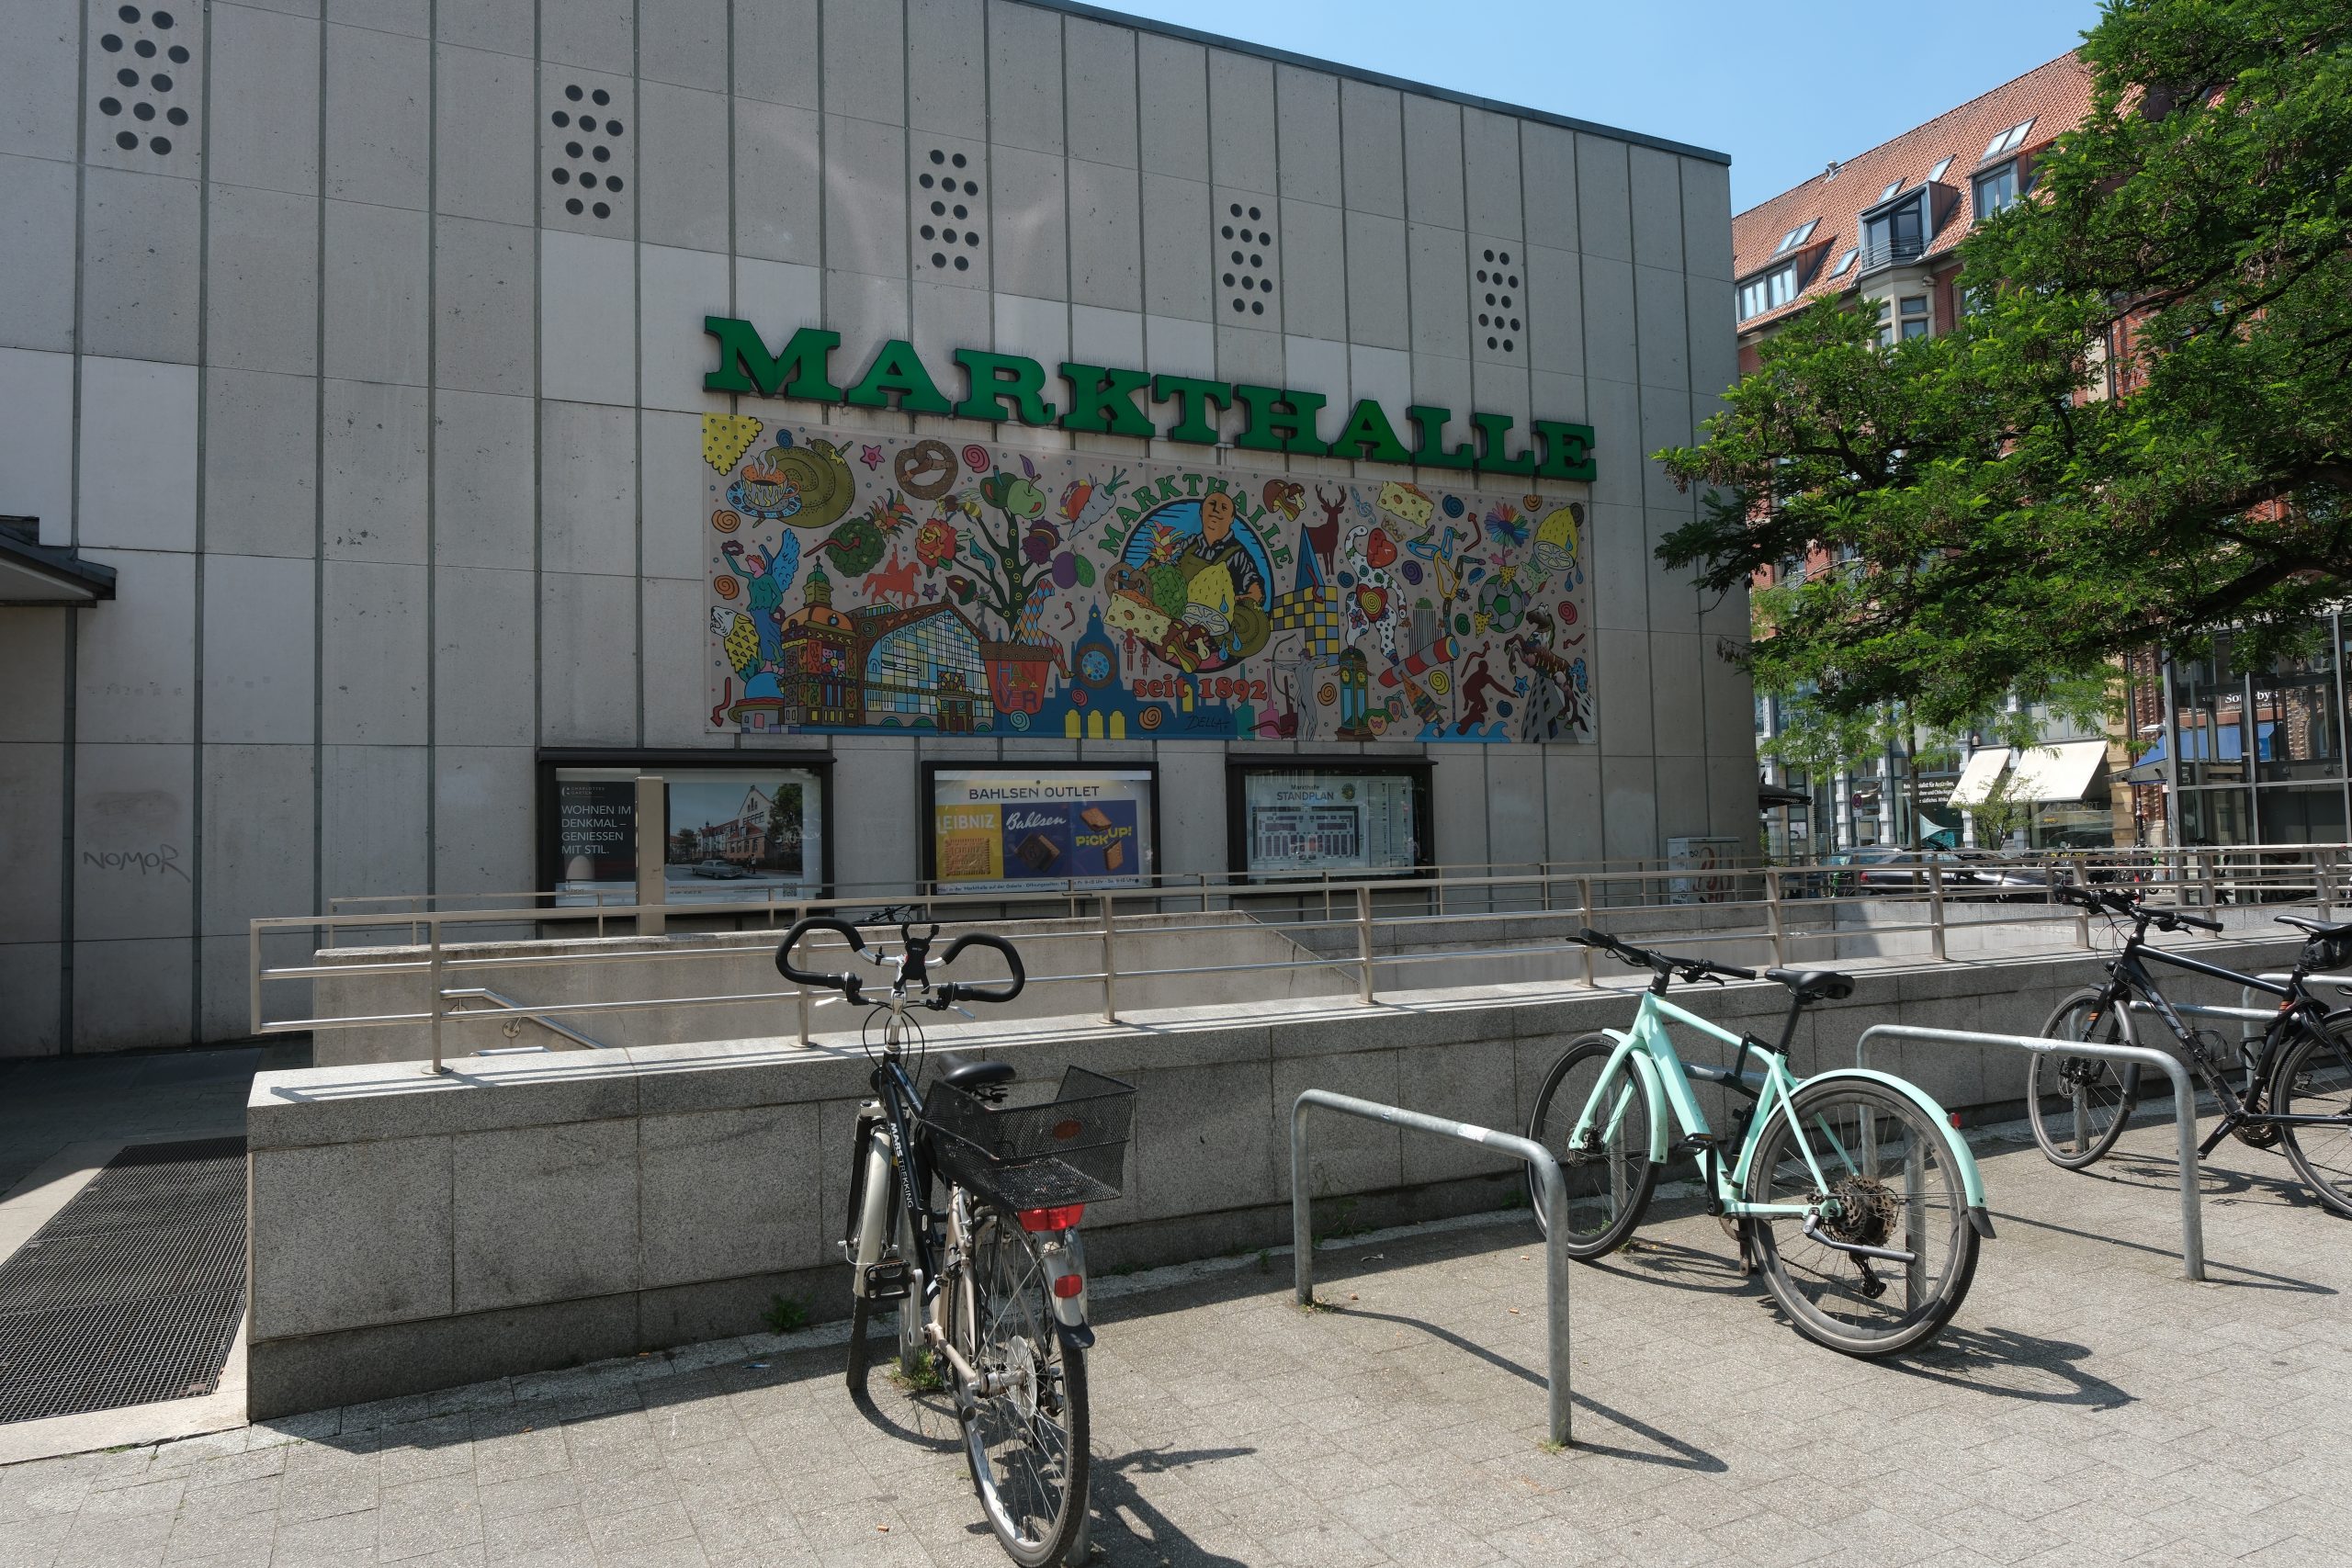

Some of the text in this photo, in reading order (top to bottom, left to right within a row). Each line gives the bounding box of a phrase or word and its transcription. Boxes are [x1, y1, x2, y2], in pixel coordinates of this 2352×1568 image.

[704, 316, 1596, 481] MARKTHALLE
[1098, 474, 1294, 569] MARKTHALLE
[1133, 673, 1267, 703] seit 1892
[969, 785, 1100, 800] BAHLSEN OUTLET
[1277, 791, 1334, 801] STANDPLAN
[561, 805, 631, 815] WOHNEN IM
[561, 818, 617, 828] DENKMAL
[936, 814, 995, 834] LEIBNIZ
[1006, 811, 1067, 830] Bahlsen
[561, 831, 624, 841] GENIESSEN
[561, 845, 610, 854] MIT STIL.
[889, 1122, 914, 1208] MARS TREKKING
